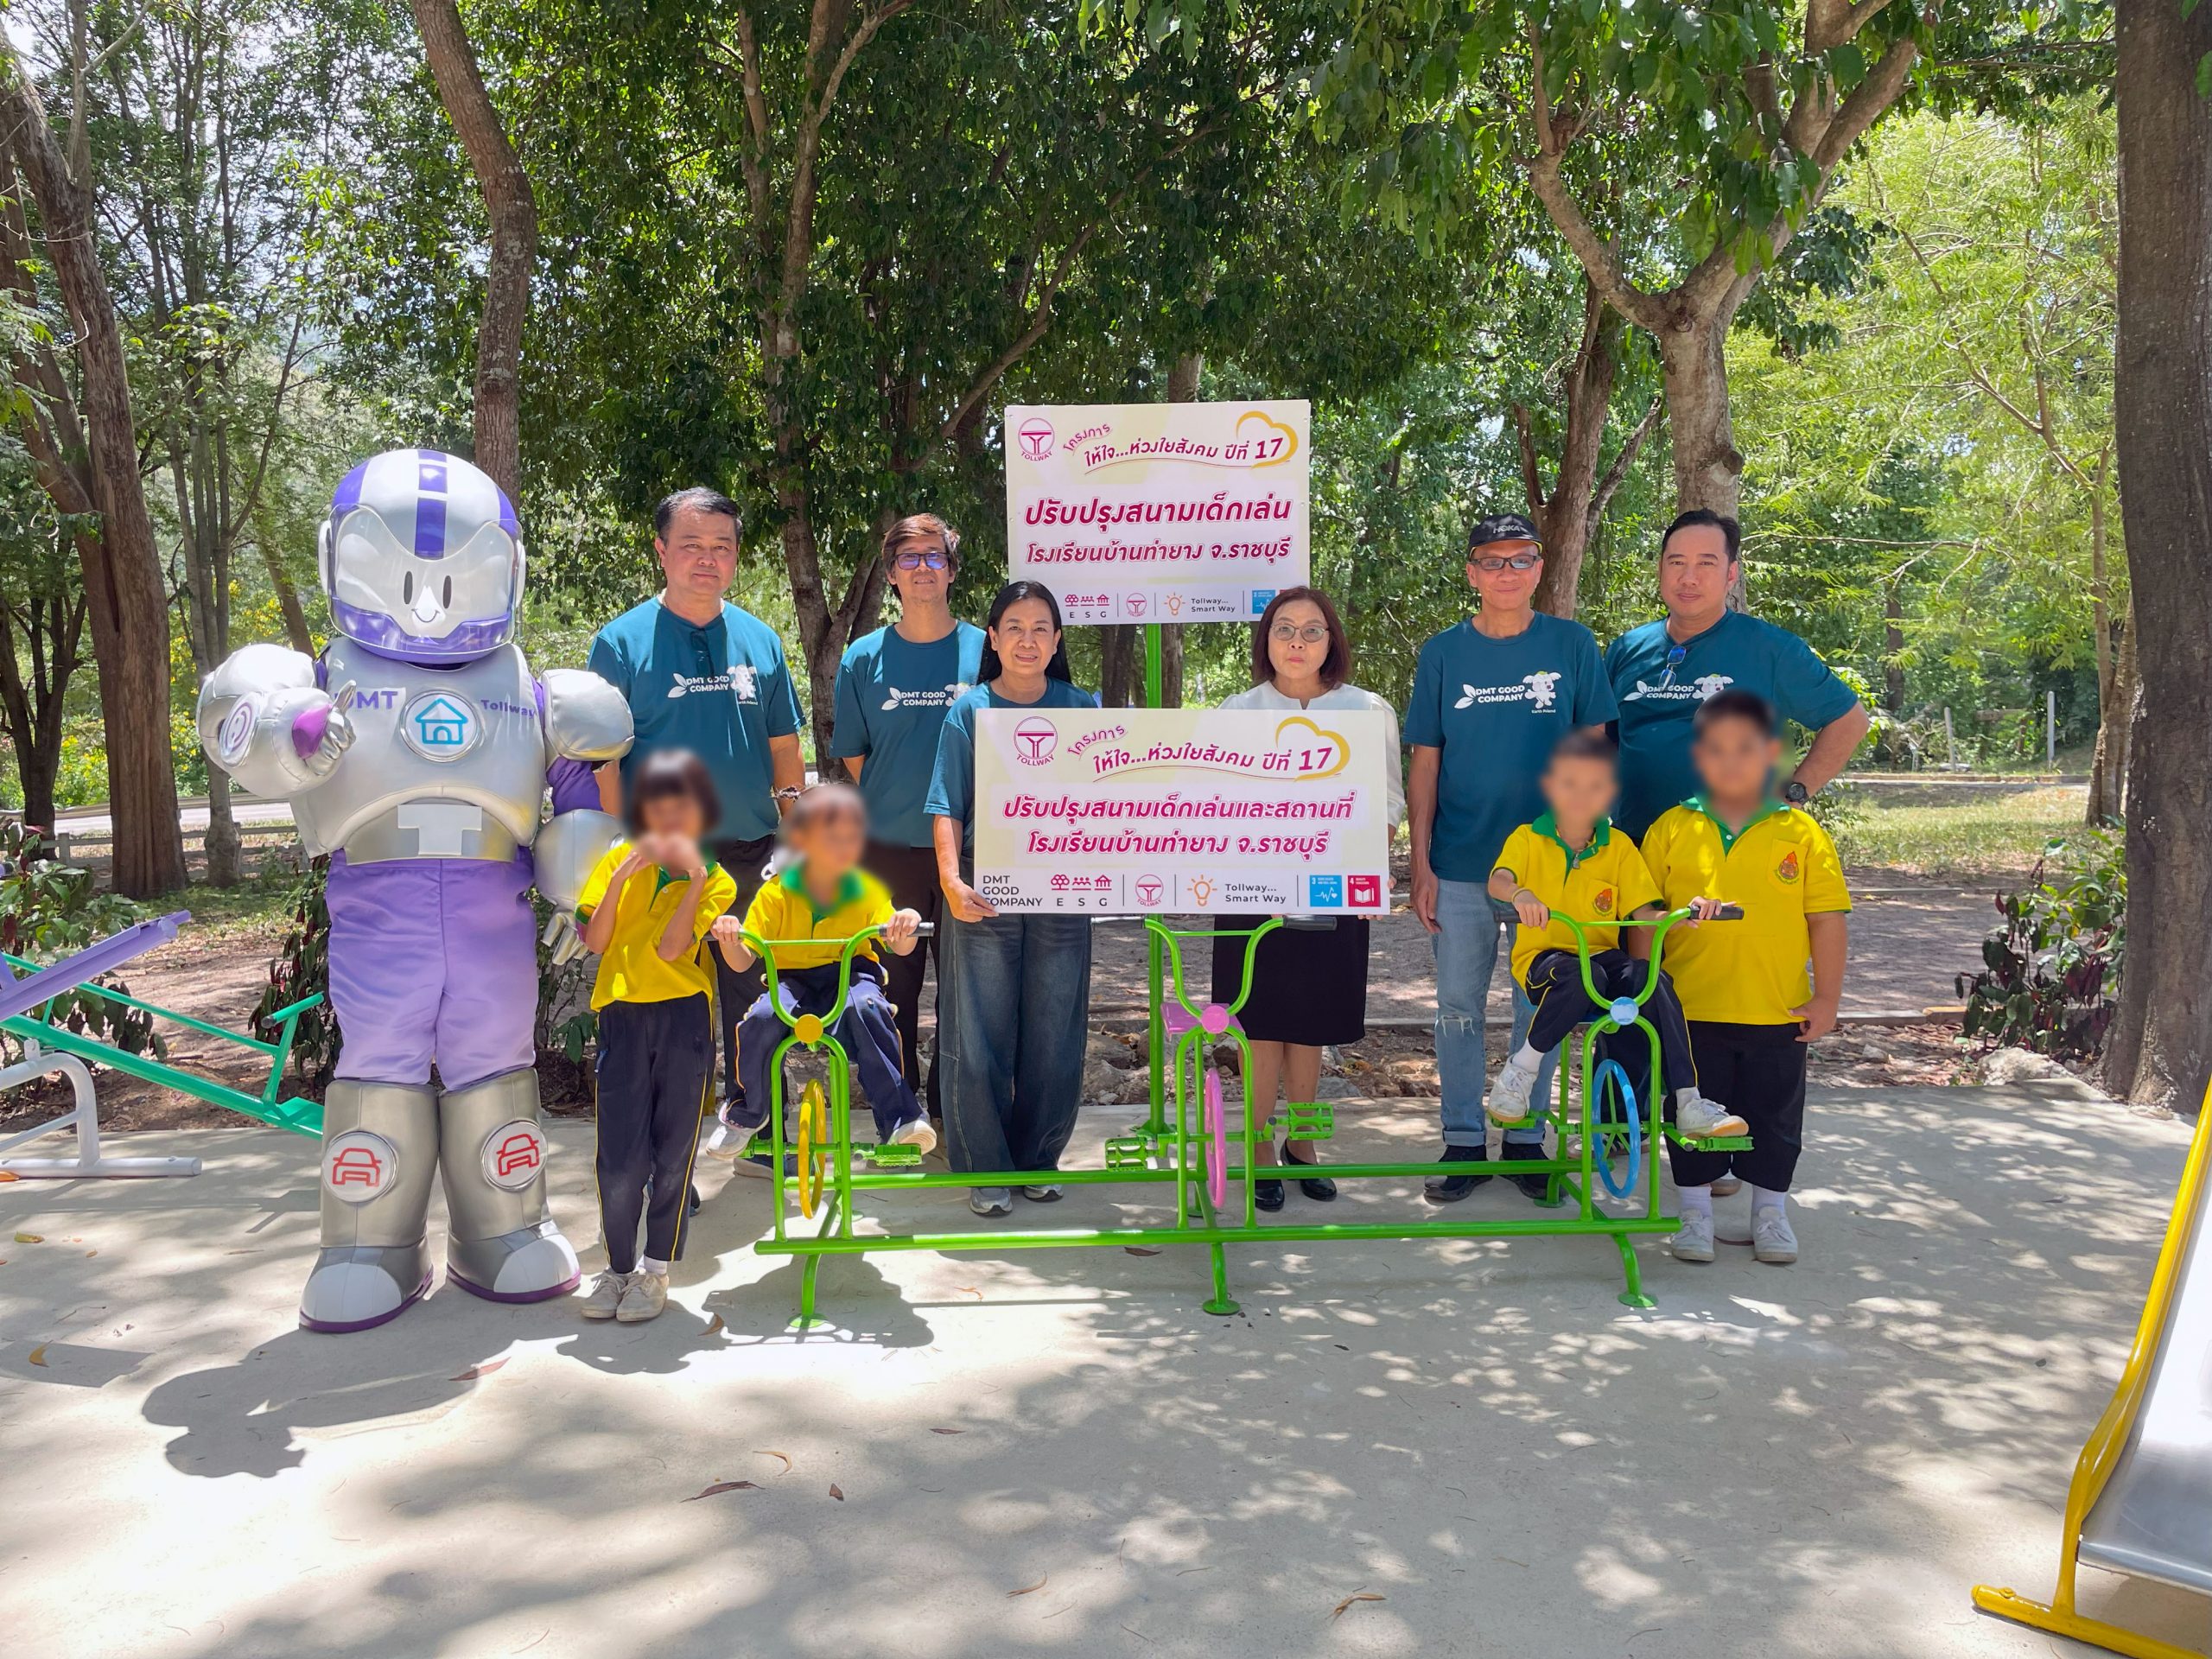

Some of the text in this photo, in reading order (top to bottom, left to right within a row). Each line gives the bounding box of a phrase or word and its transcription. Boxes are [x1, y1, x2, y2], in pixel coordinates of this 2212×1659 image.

[1063, 423, 1111, 451] โครงการ
[1224, 440, 1250, 460] ปีที่
[1255, 437, 1283, 460] 17
[1020, 450, 1053, 461] TOLLWAY
[1025, 492, 1293, 532] ปรับปรุงสนามเด็กเล่น
[1492, 524, 1521, 534] HOKA
[1027, 537, 1292, 564] โรงเรียนบ้านท่ายาง จ.ราชบุรี
[1475, 684, 1526, 696] DMT GOOD
[1668, 684, 1695, 693] GOOD
[1478, 693, 1524, 703] COMPANY
[480, 699, 537, 720] Tollway
[1067, 724, 1125, 756] โครงการ
[1016, 753, 1055, 766] TOLLWAY
[1262, 749, 1292, 772] ปีที่
[1299, 747, 1332, 772] 17
[1004, 791, 1356, 825] ปรับปรุงสนามเด็กเล่นและสถานที่
[1027, 830, 1331, 861] โรงเรียนบ้านท่ายาง จ.ราชบุรี
[982, 875, 1010, 884] DMT
[982, 886, 1020, 895] GOOD
[984, 897, 1044, 906] OMPANY
[1057, 898, 1108, 906] E S G
[1137, 898, 1161, 907] TOLLWAY
[1225, 894, 1287, 905] Smart Way
